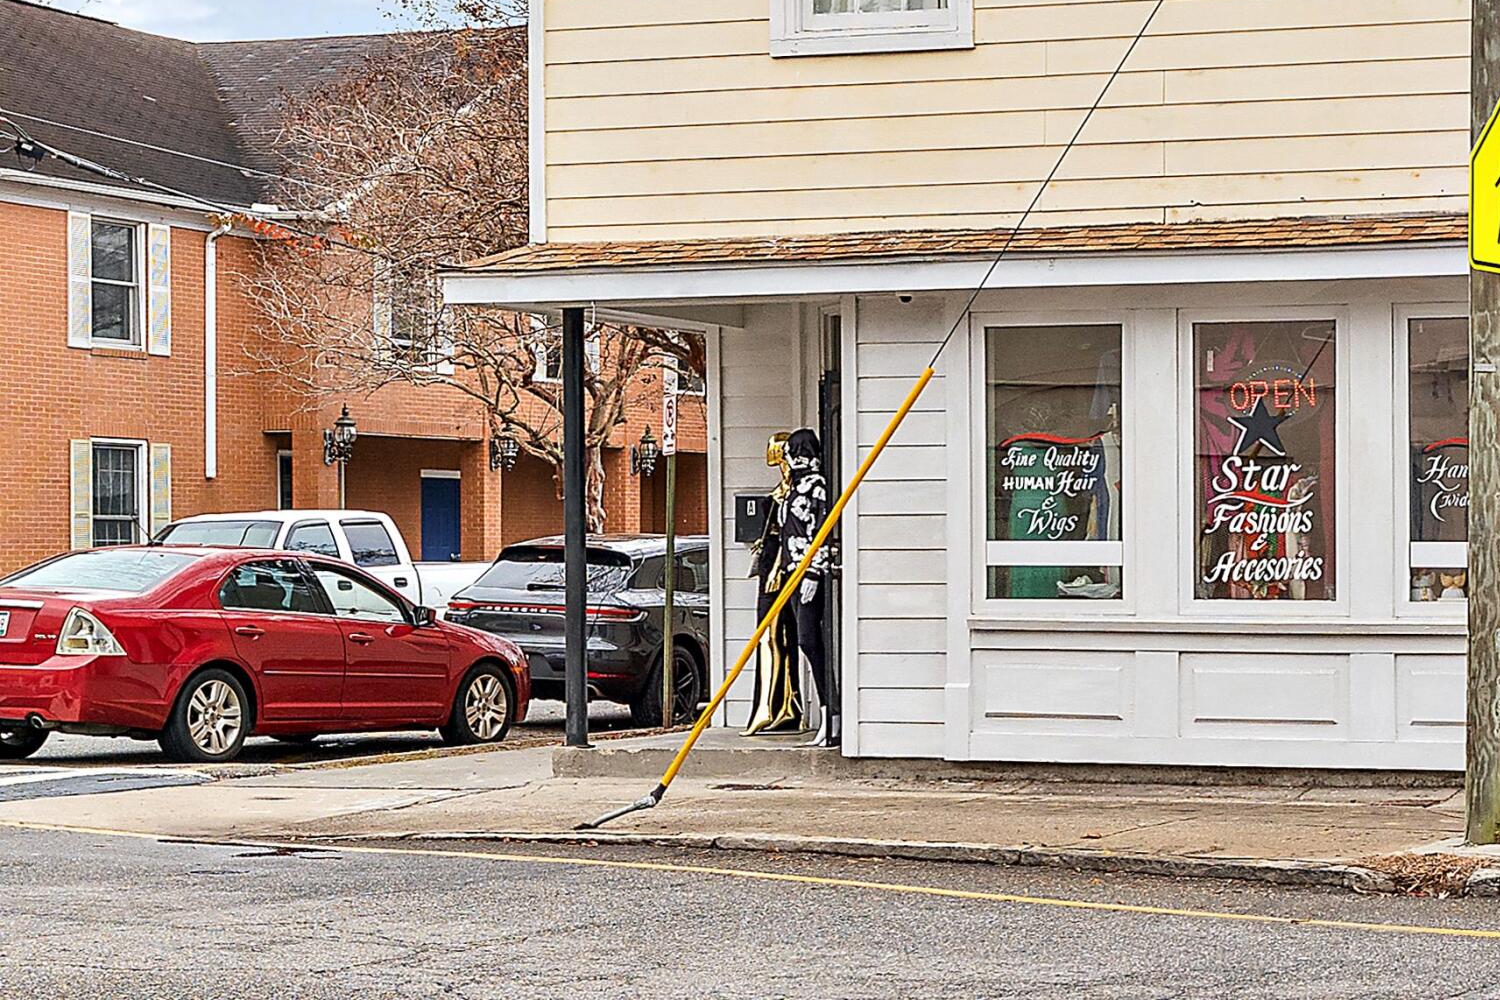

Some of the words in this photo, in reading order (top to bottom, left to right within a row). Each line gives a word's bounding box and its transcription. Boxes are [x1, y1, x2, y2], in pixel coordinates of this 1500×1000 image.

[1230, 379, 1316, 410] OPEN
[1001, 447, 1036, 471] Fine
[1043, 446, 1099, 472] Quality
[1212, 456, 1302, 493] Star
[1002, 475, 1054, 491] HUMAN
[1050, 471, 1098, 496] Hair
[1042, 496, 1057, 510] &
[1204, 502, 1313, 535] Fashions
[1018, 509, 1078, 540] Wigs
[1251, 533, 1268, 551] &
[1203, 551, 1323, 584] Accesories
